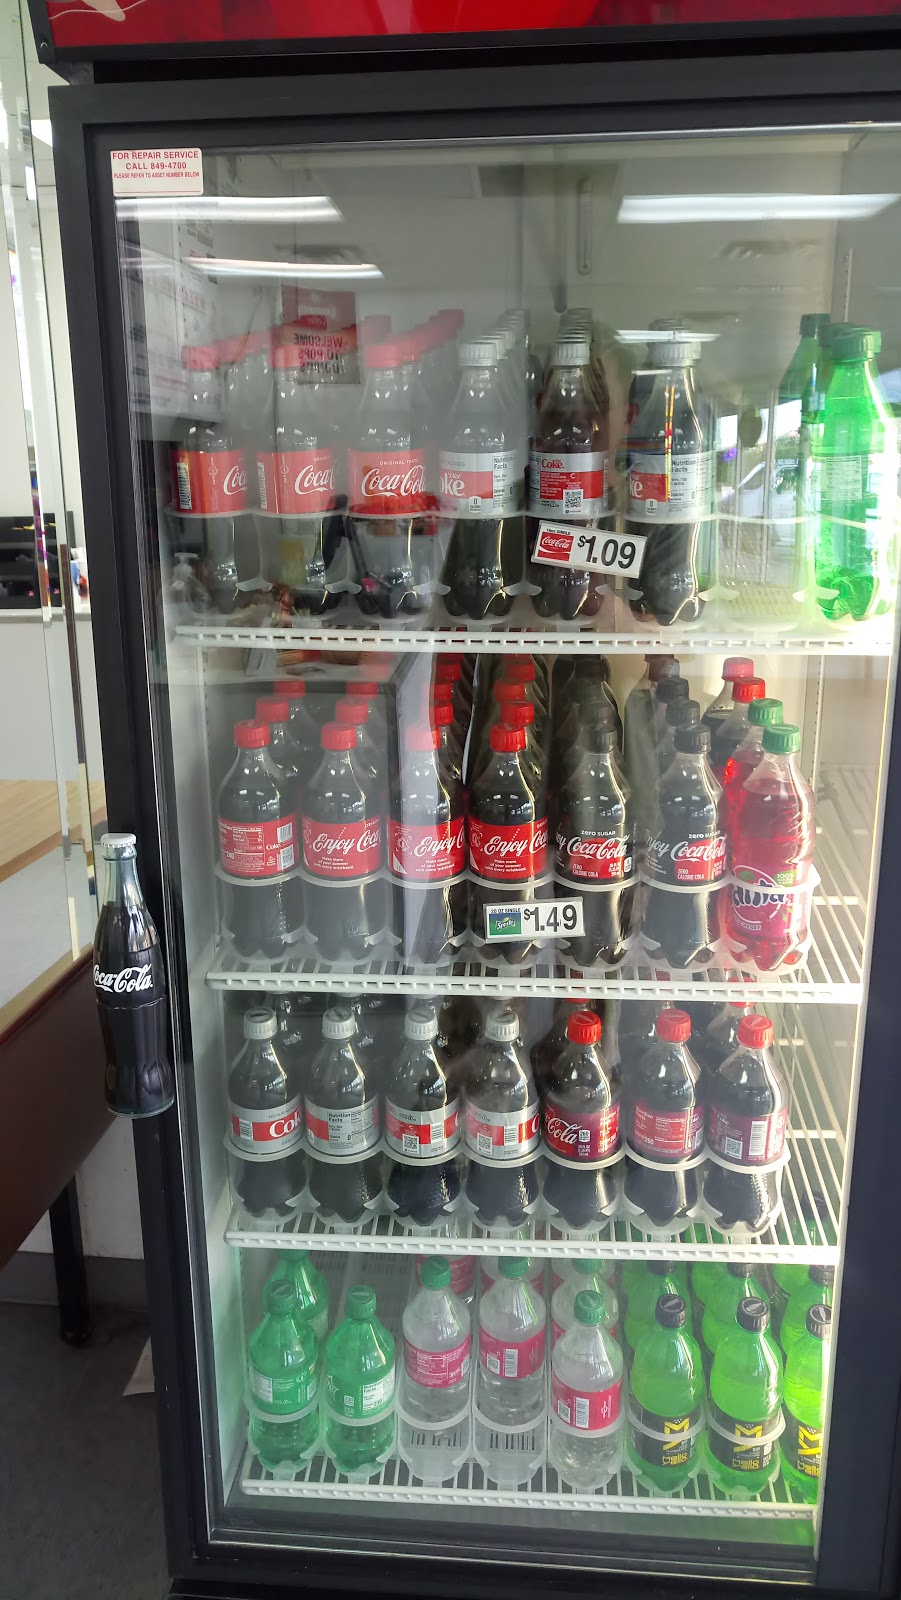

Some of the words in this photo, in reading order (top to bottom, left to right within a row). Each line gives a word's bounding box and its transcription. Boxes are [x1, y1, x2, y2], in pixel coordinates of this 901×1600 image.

[112, 152, 129, 160] FOR
[132, 152, 161, 160] REPAIR
[163, 151, 199, 159] SERVICE
[150, 162, 187, 170] 849-4700
[578, 535, 636, 569] $1.09
[312, 833, 355, 855] Enjoy
[414, 836, 456, 857] Enjoy
[484, 836, 528, 856] Enjoy
[567, 834, 630, 860] Coca-Cola
[670, 833, 727, 862] Coca-Cola
[573, 869, 588, 877] CALORIE
[588, 870, 599, 878] COLA
[496, 920, 514, 930] Sprite
[524, 904, 578, 932] $1.49
[93, 963, 153, 993] Coca-Cola
